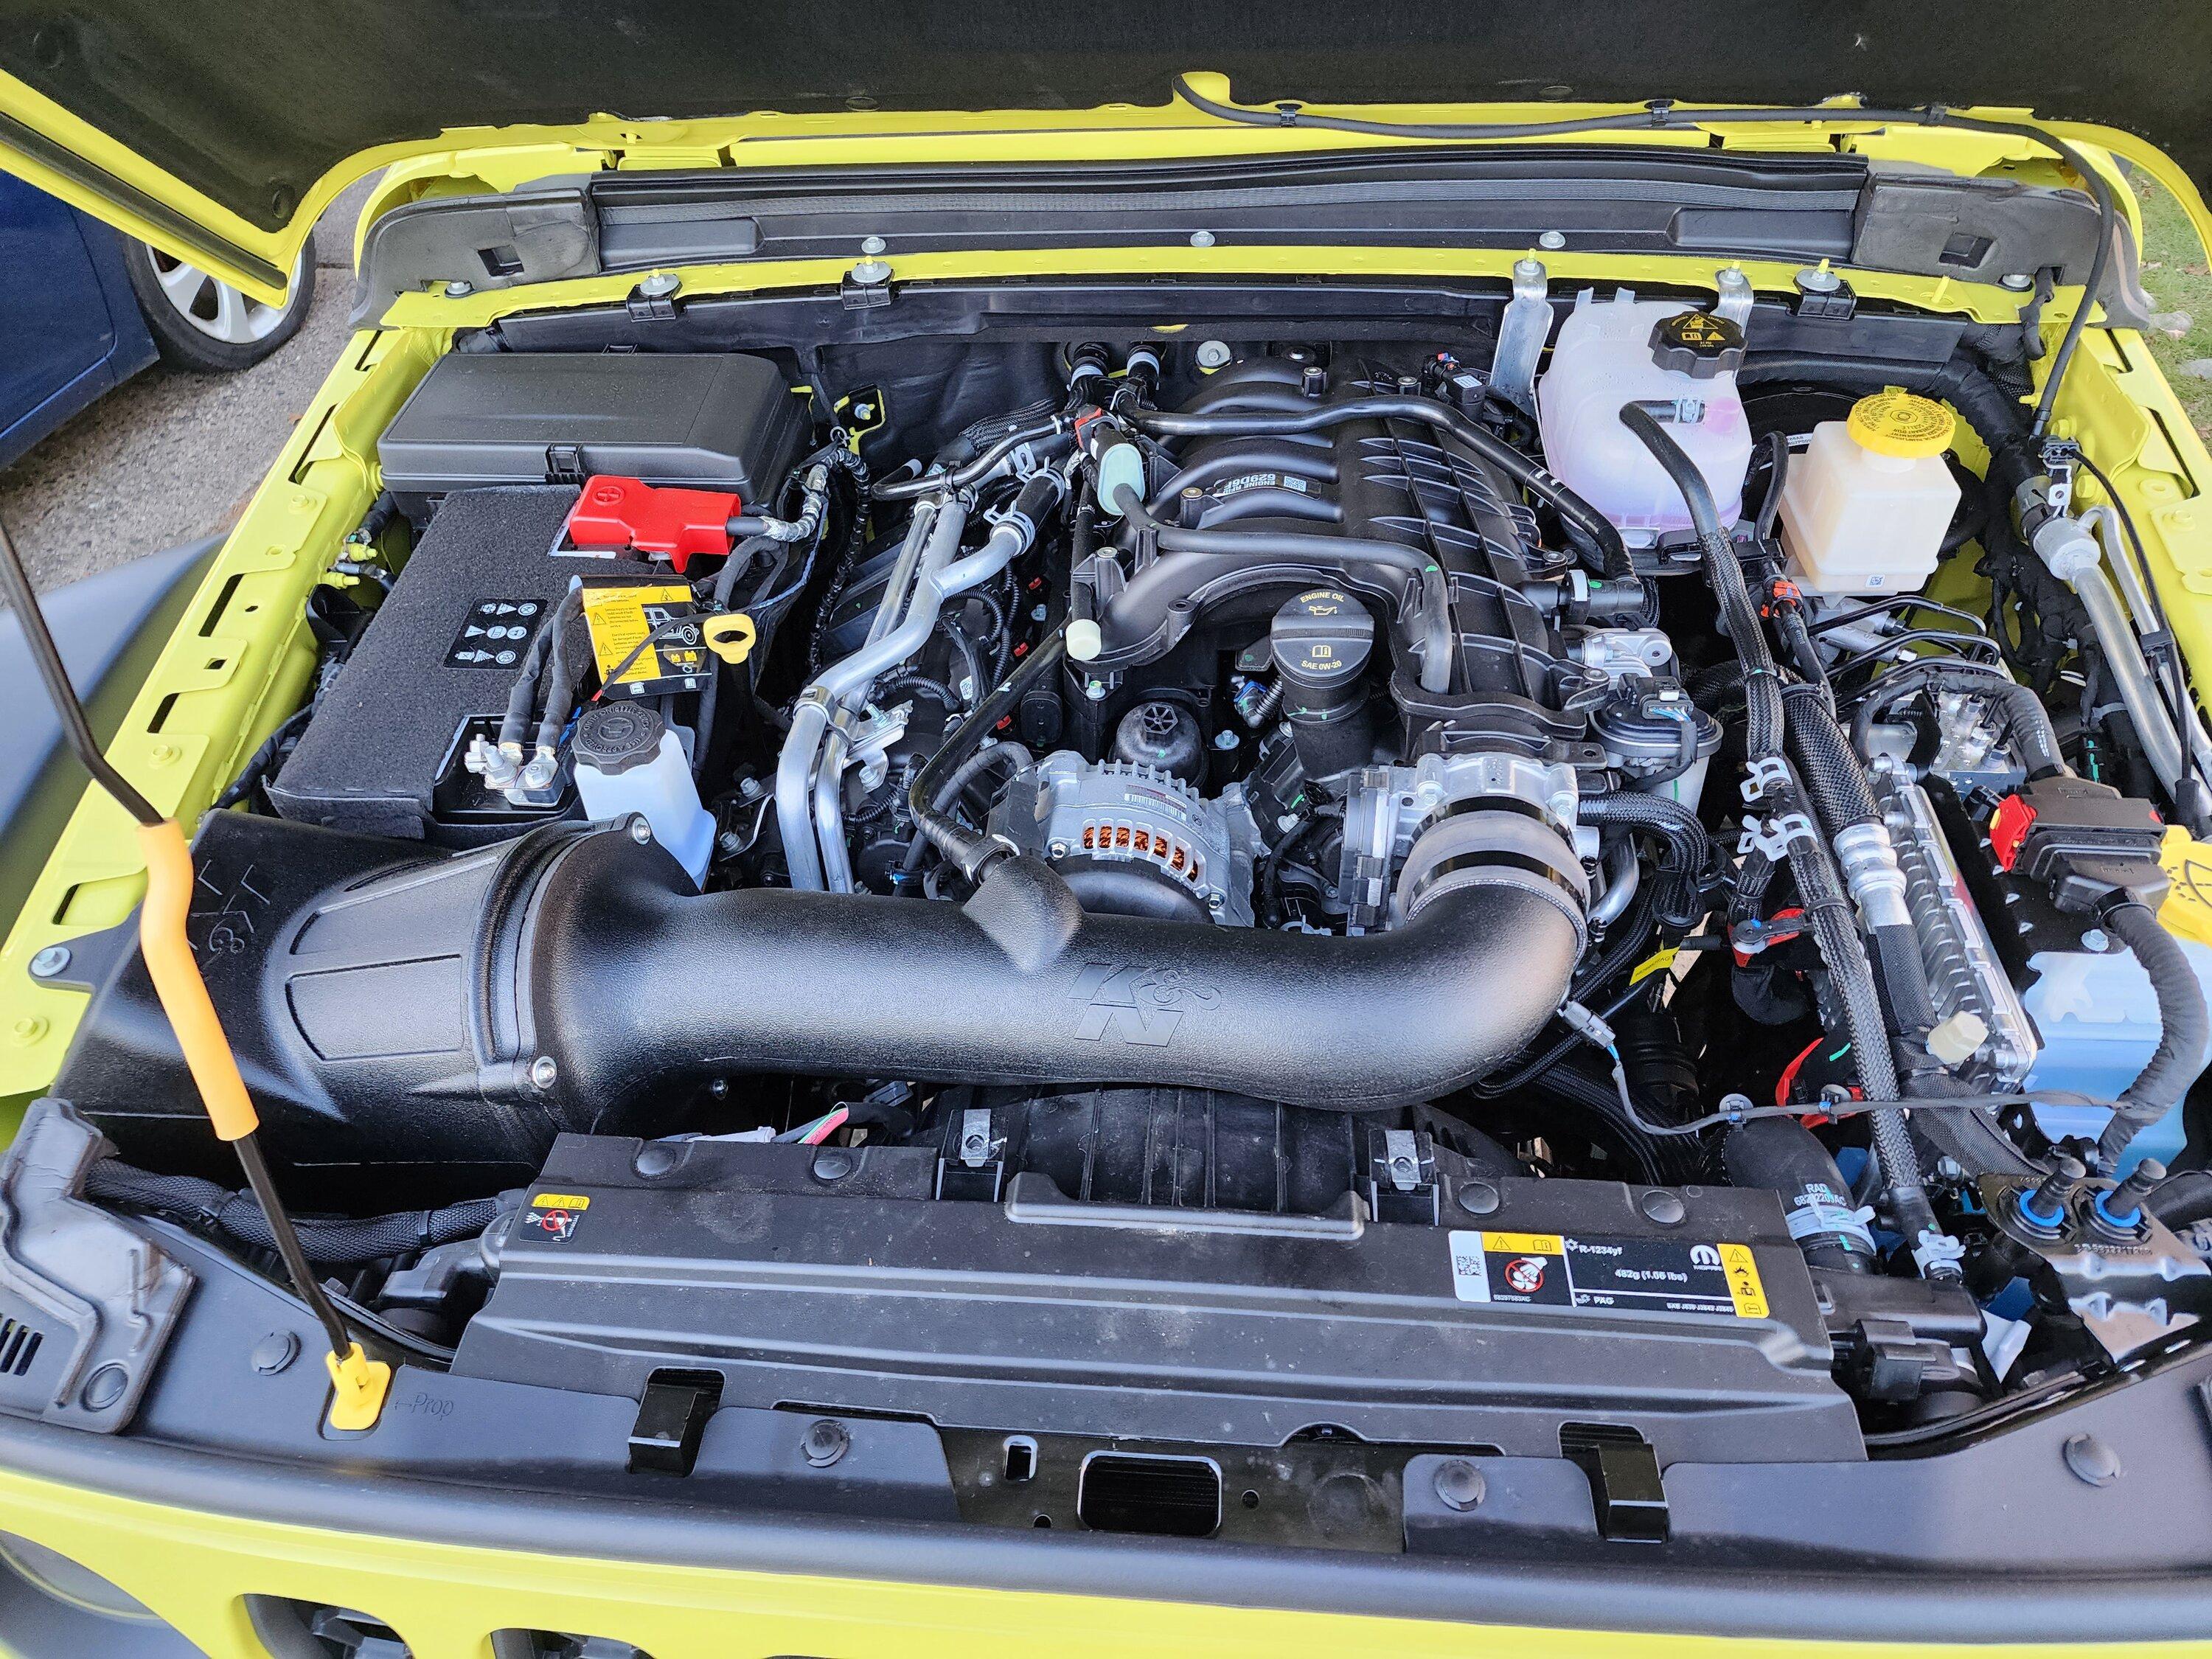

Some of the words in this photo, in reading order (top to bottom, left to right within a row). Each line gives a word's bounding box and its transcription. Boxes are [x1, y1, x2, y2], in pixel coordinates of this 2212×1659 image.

[1223, 473, 1276, 489] 629D6F
[1244, 480, 1276, 488] ENGINE
[1222, 485, 1242, 495] RFID
[1300, 591, 1330, 603] ENGINE
[1332, 593, 1344, 602] OIL
[1301, 660, 1318, 669] SAE
[1318, 660, 1342, 670] 0W-20
[599, 706, 637, 716] STEERING
[583, 714, 599, 731] FLUID
[584, 738, 625, 753] APPROVED
[625, 737, 641, 749] USE
[1805, 1183, 1829, 1194] RAD
[1668, 1271, 1688, 1283] lbs)
[1593, 1297, 1615, 1305] PAG
[411, 1392, 454, 1422] Prop
